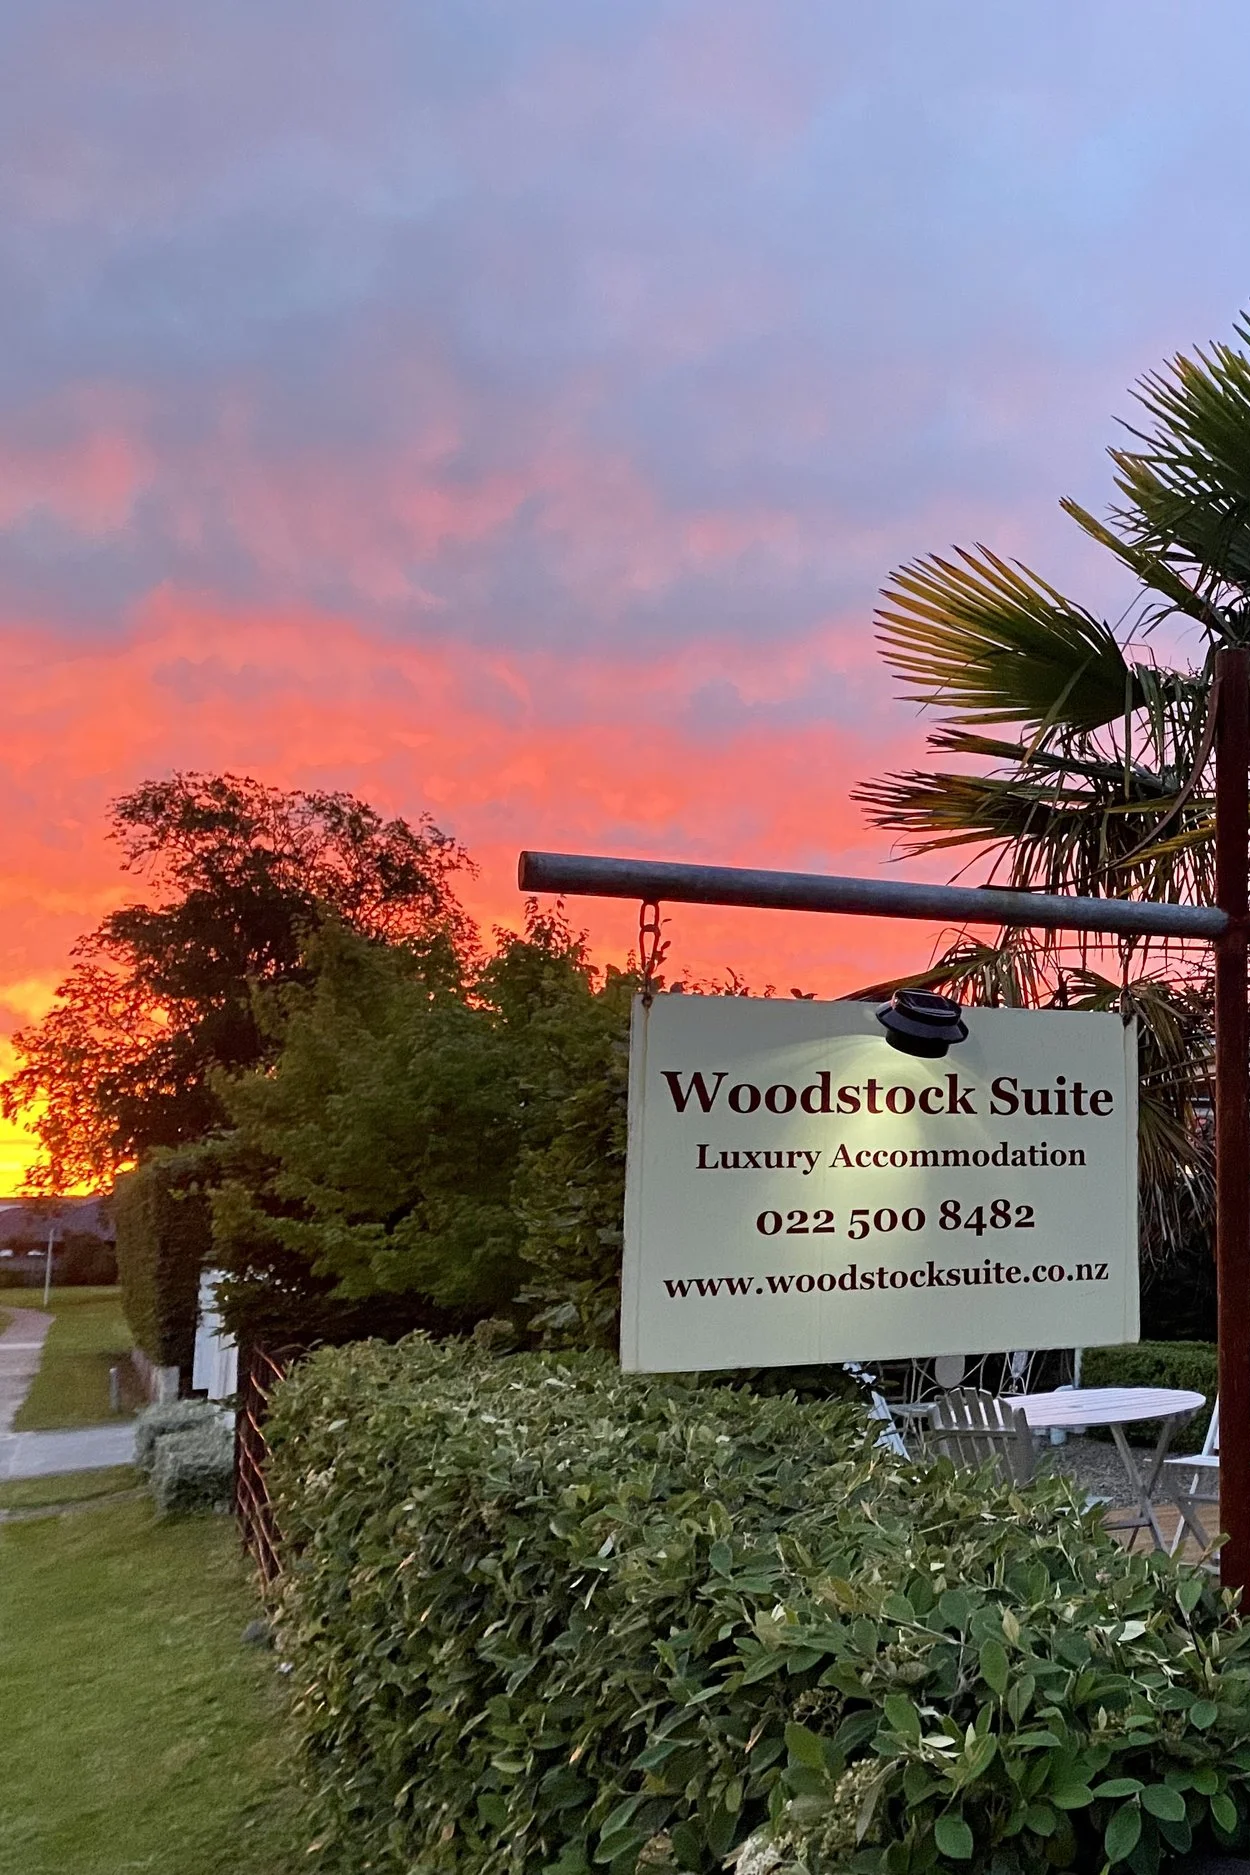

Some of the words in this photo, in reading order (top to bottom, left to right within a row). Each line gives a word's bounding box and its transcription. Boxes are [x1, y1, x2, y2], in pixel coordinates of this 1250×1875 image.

[660, 1070, 978, 1115] Woodstock
[989, 1075, 1114, 1117] Suite
[695, 1143, 822, 1175] Luxury
[828, 1141, 1087, 1169] Accommodation
[756, 1209, 835, 1236] 022
[847, 1207, 926, 1240] 500
[938, 1198, 1035, 1237] 8482
[662, 1258, 1109, 1299] www.woodstocksuite.co.nz
